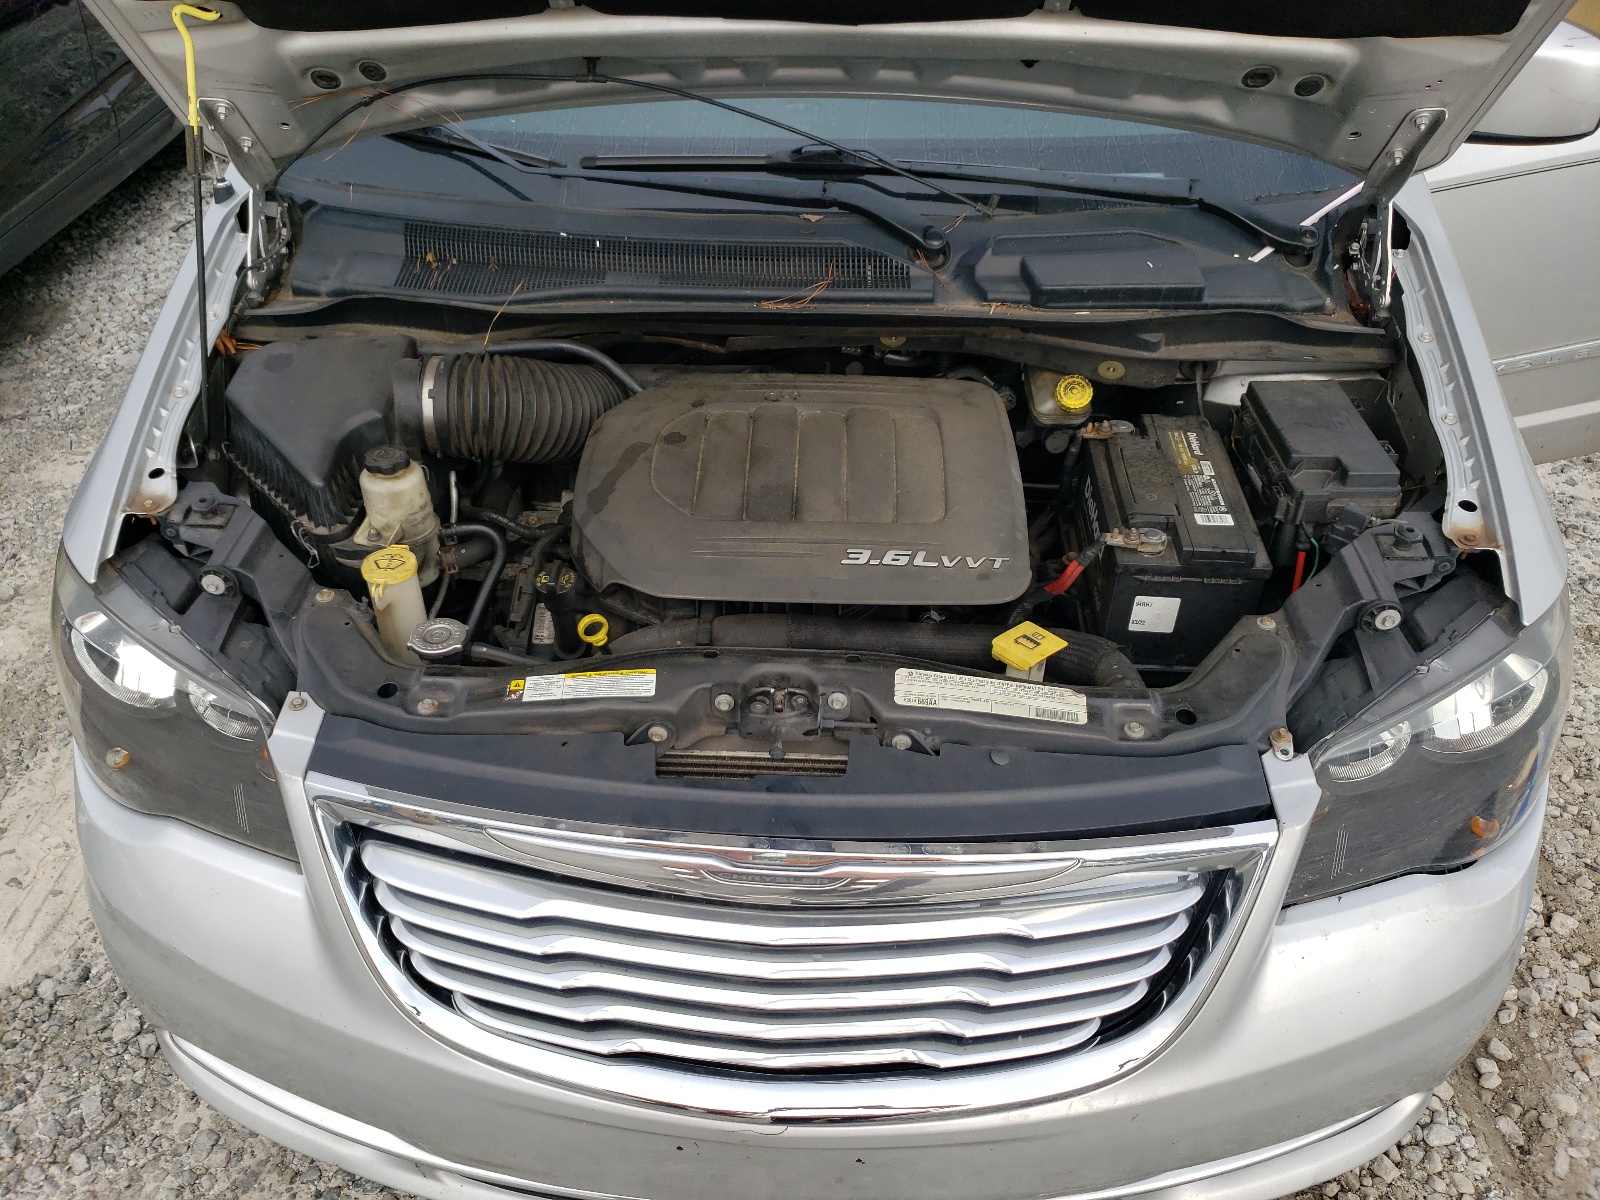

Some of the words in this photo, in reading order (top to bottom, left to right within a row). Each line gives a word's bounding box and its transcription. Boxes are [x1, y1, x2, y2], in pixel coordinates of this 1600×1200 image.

[1186, 431, 1204, 456] DieHard
[840, 548, 939, 567] 3.6L
[941, 555, 1010, 569] VVT
[717, 872, 831, 885] CHRYSLER
